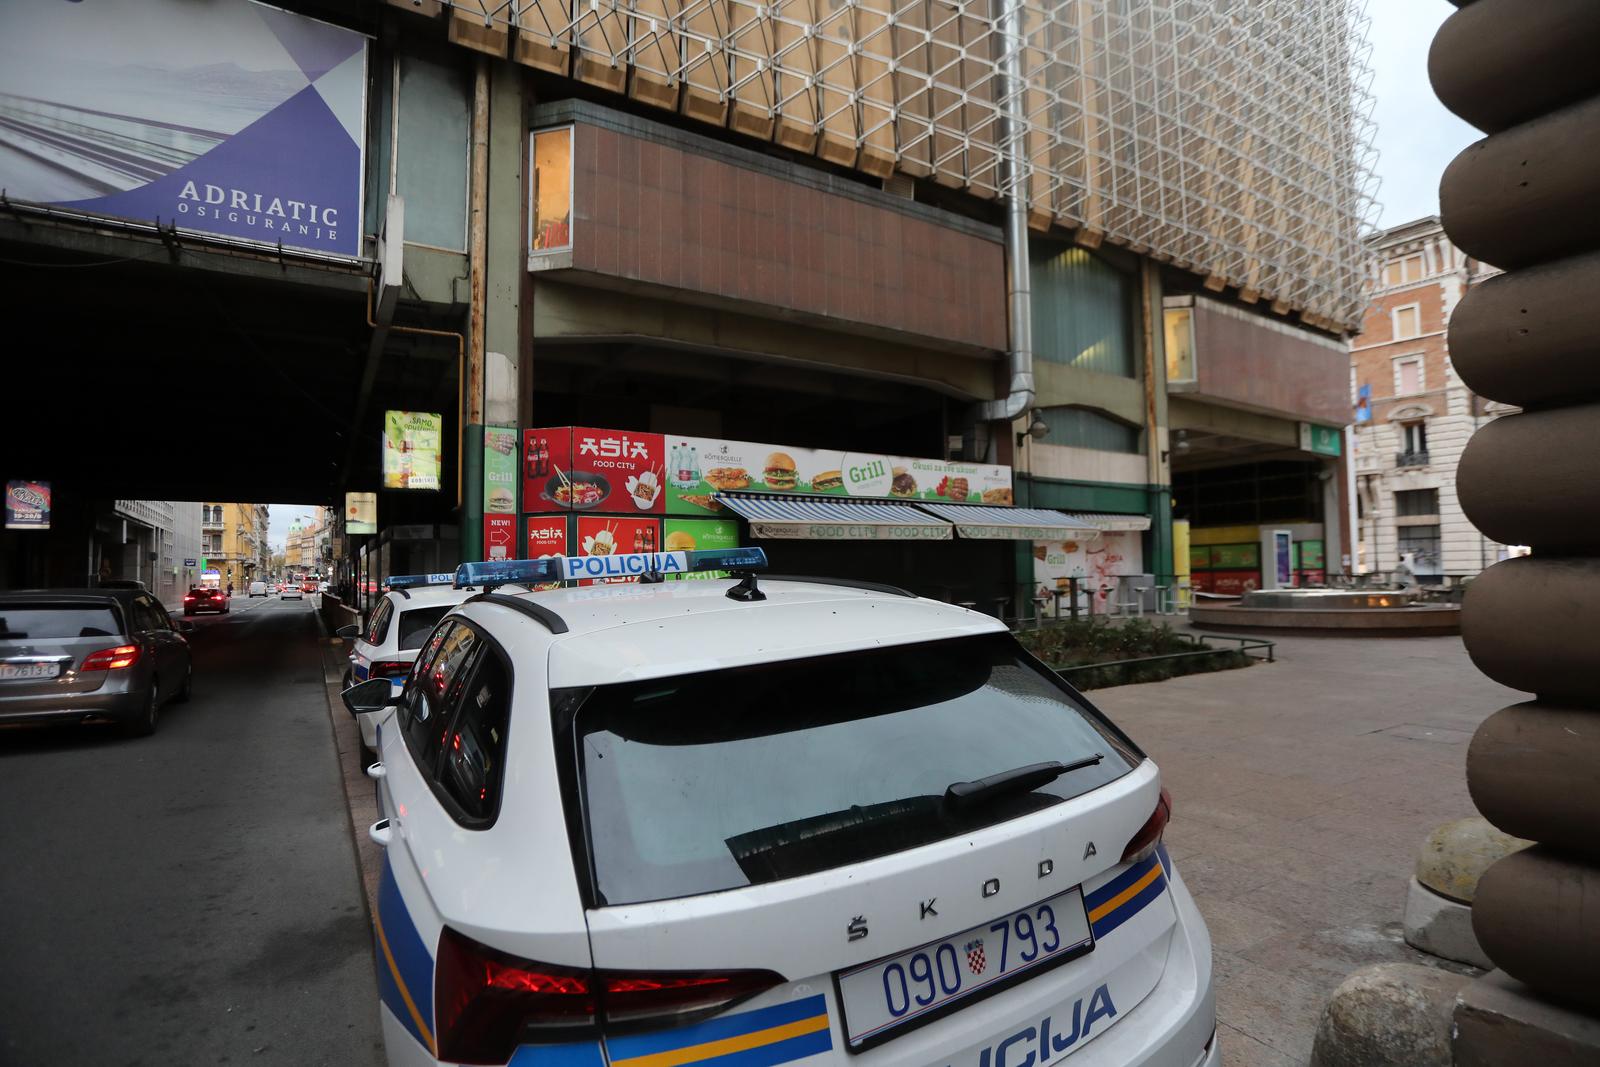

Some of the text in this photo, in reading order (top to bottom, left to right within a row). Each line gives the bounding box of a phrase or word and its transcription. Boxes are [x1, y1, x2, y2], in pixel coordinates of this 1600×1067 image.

[178, 180, 338, 227] ADRIATIC
[177, 202, 337, 240] OSIGURANJE
[593, 460, 636, 470] FOOD CITY
[848, 460, 885, 484] Grill
[488, 471, 513, 483] Grill
[491, 519, 511, 527] NEW!
[809, 524, 845, 538] FOOD
[849, 525, 878, 539] CITY
[887, 526, 920, 538] FOOD
[568, 553, 681, 576] POLICIJA
[848, 840, 1098, 942] ŠKODA
[882, 904, 1060, 1017] 090 793
